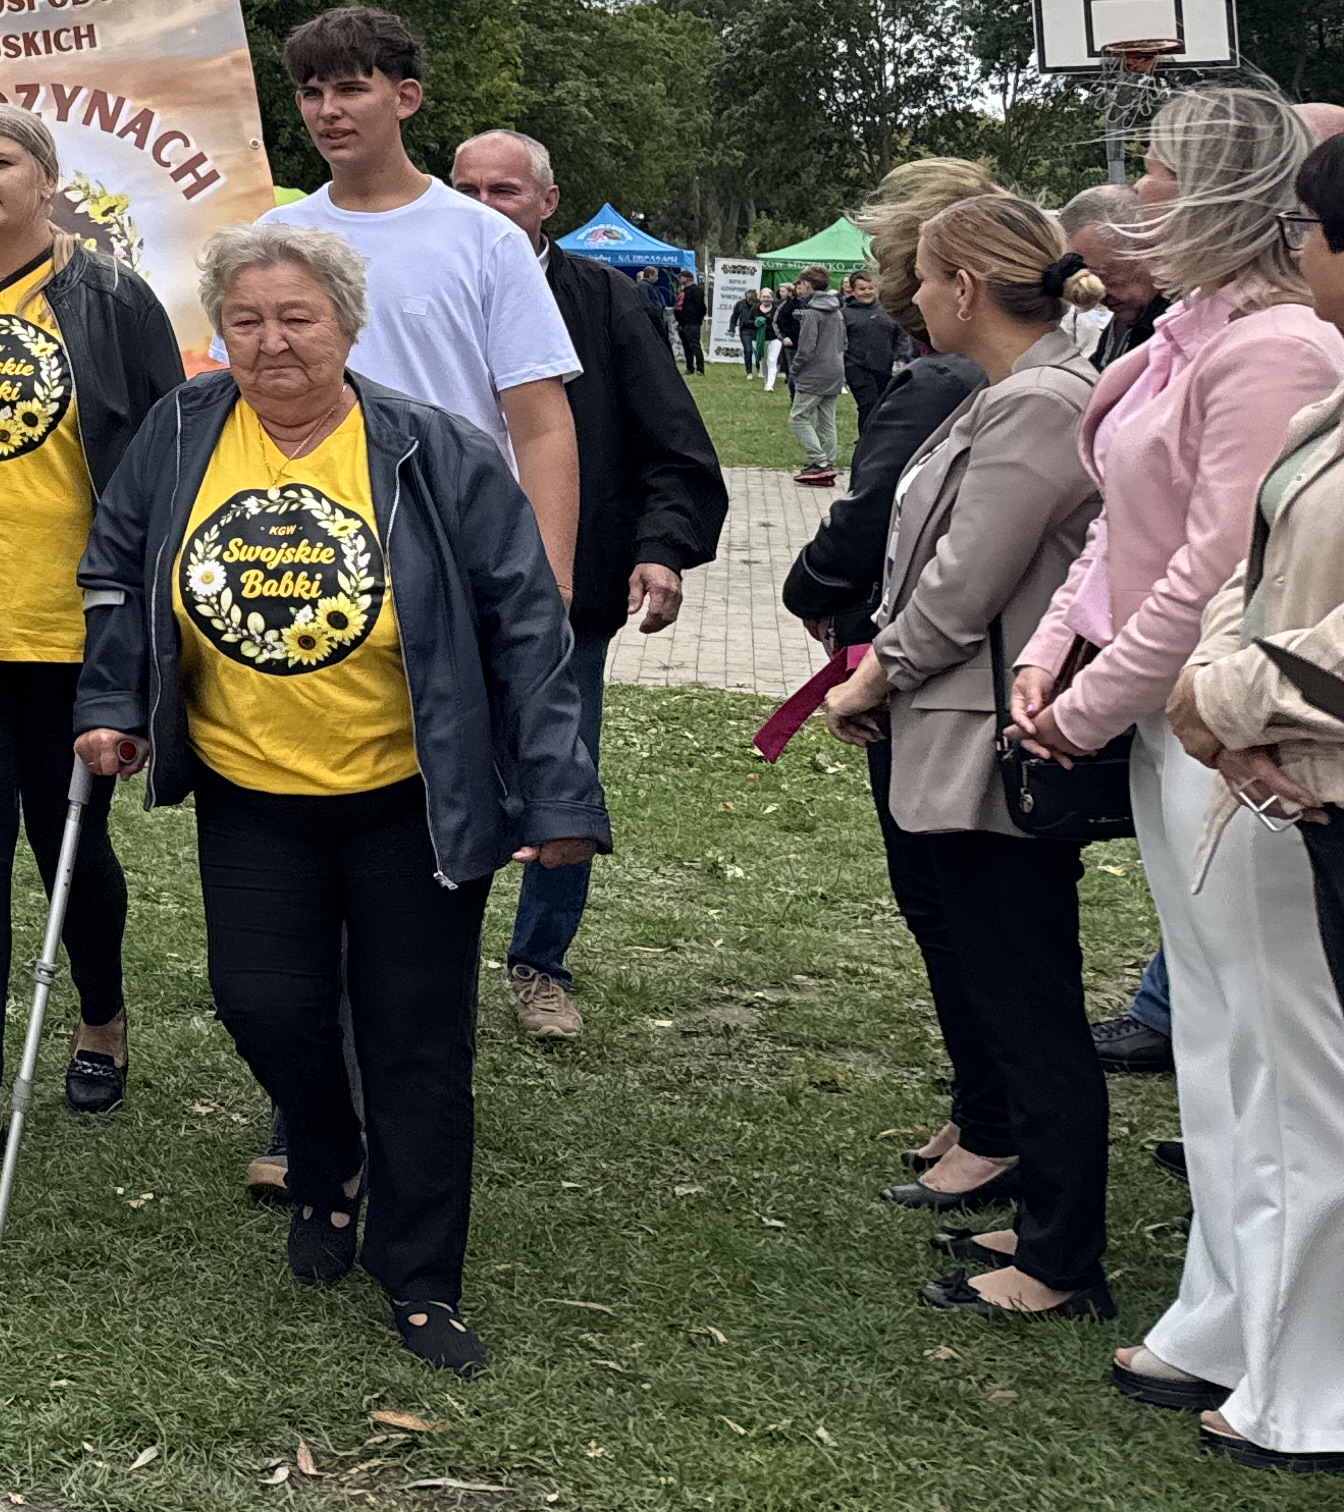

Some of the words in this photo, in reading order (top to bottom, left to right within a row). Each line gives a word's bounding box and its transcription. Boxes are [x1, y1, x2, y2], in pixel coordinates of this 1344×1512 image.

[267, 524, 297, 536] KGW
[222, 537, 337, 570] Swojskie
[239, 568, 323, 600] Babki
